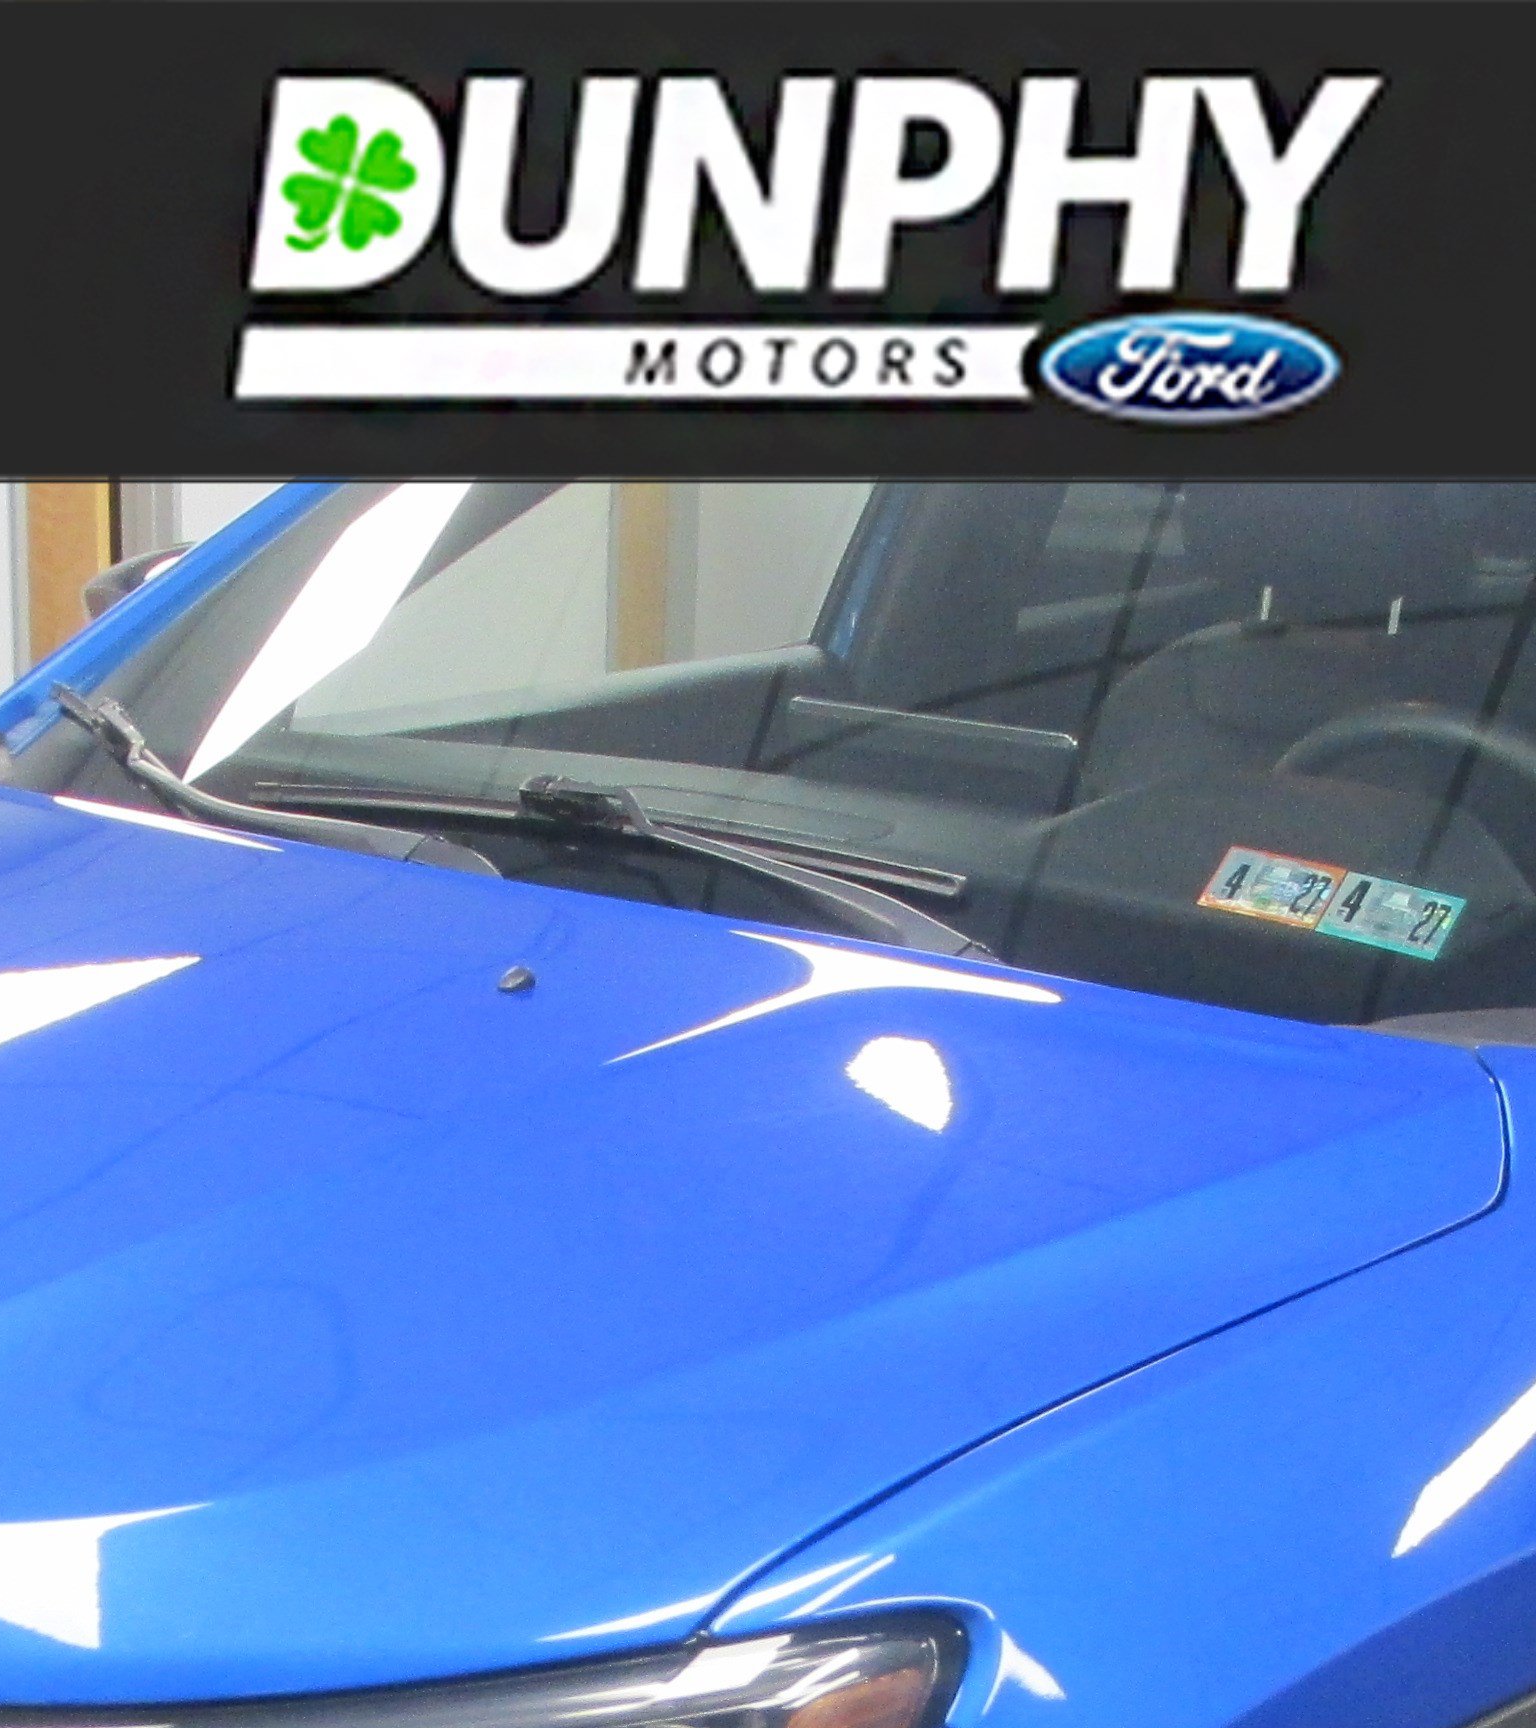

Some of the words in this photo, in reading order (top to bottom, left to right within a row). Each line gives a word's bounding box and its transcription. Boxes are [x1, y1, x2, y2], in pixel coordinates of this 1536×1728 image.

[1224, 863, 1251, 900] 4
[1340, 880, 1372, 923] 4
[1407, 901, 1452, 945] 27
